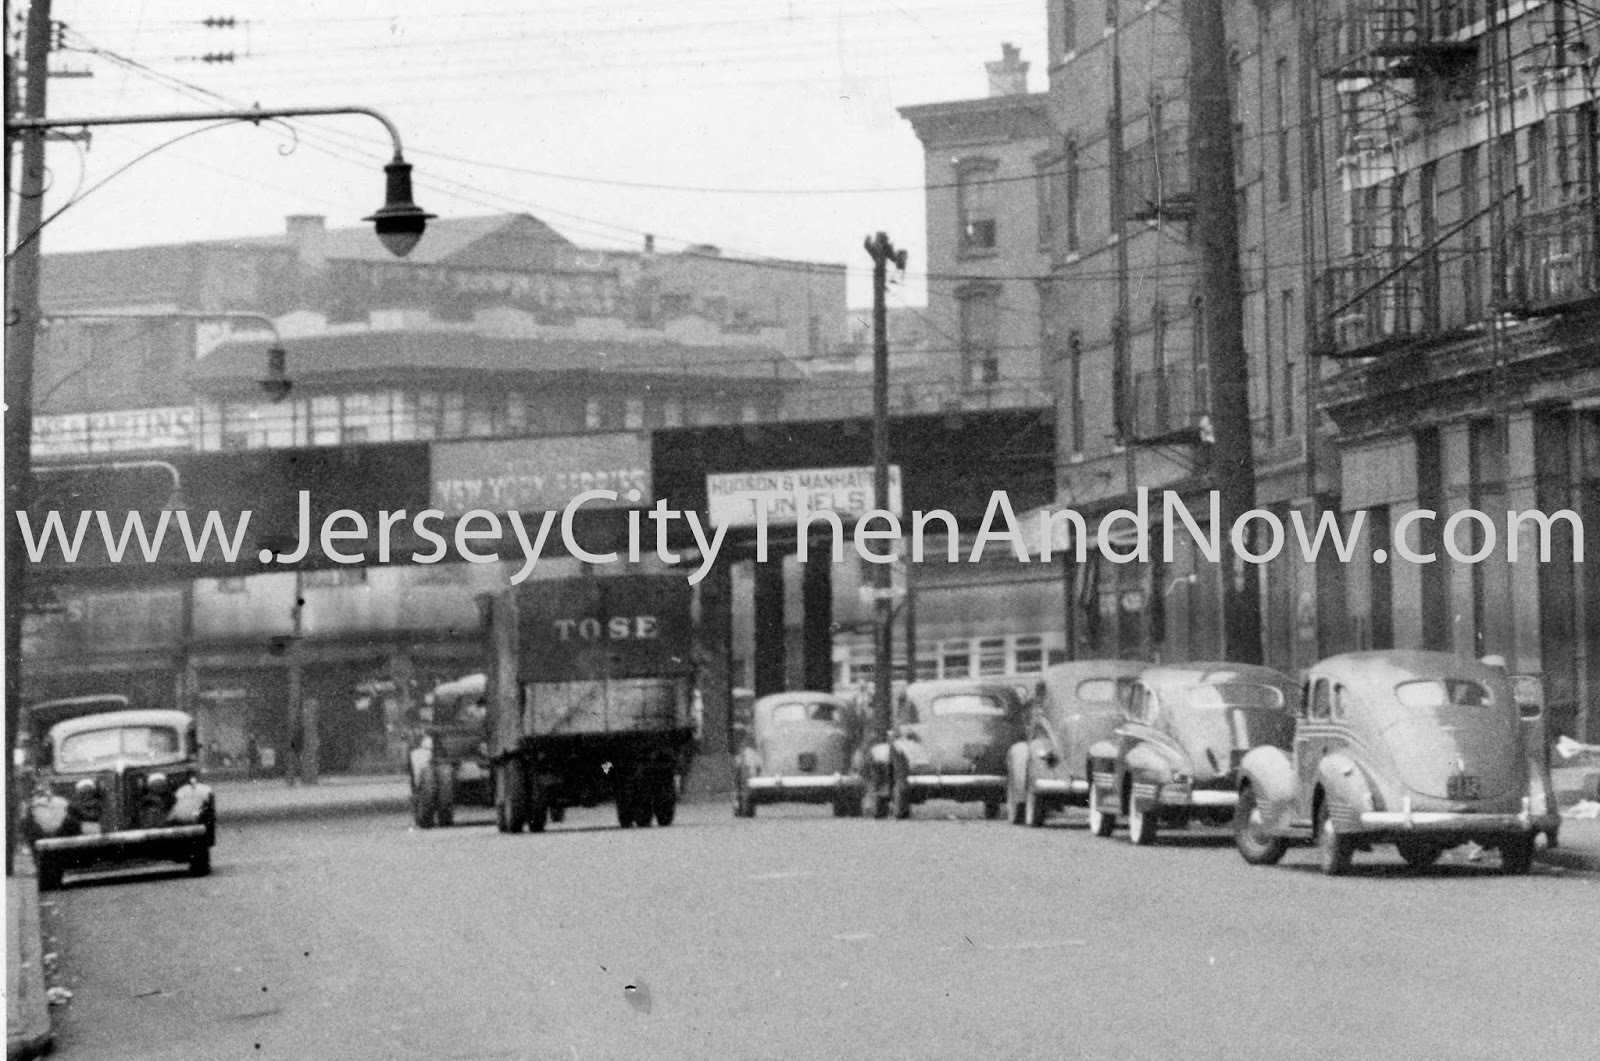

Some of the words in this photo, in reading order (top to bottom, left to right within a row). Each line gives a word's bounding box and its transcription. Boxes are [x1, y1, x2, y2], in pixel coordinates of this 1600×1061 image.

[711, 475, 778, 495] HUDSON
[783, 475, 795, 492] &
[800, 469, 897, 489] MANHATTN
[553, 615, 658, 641] TOSE
